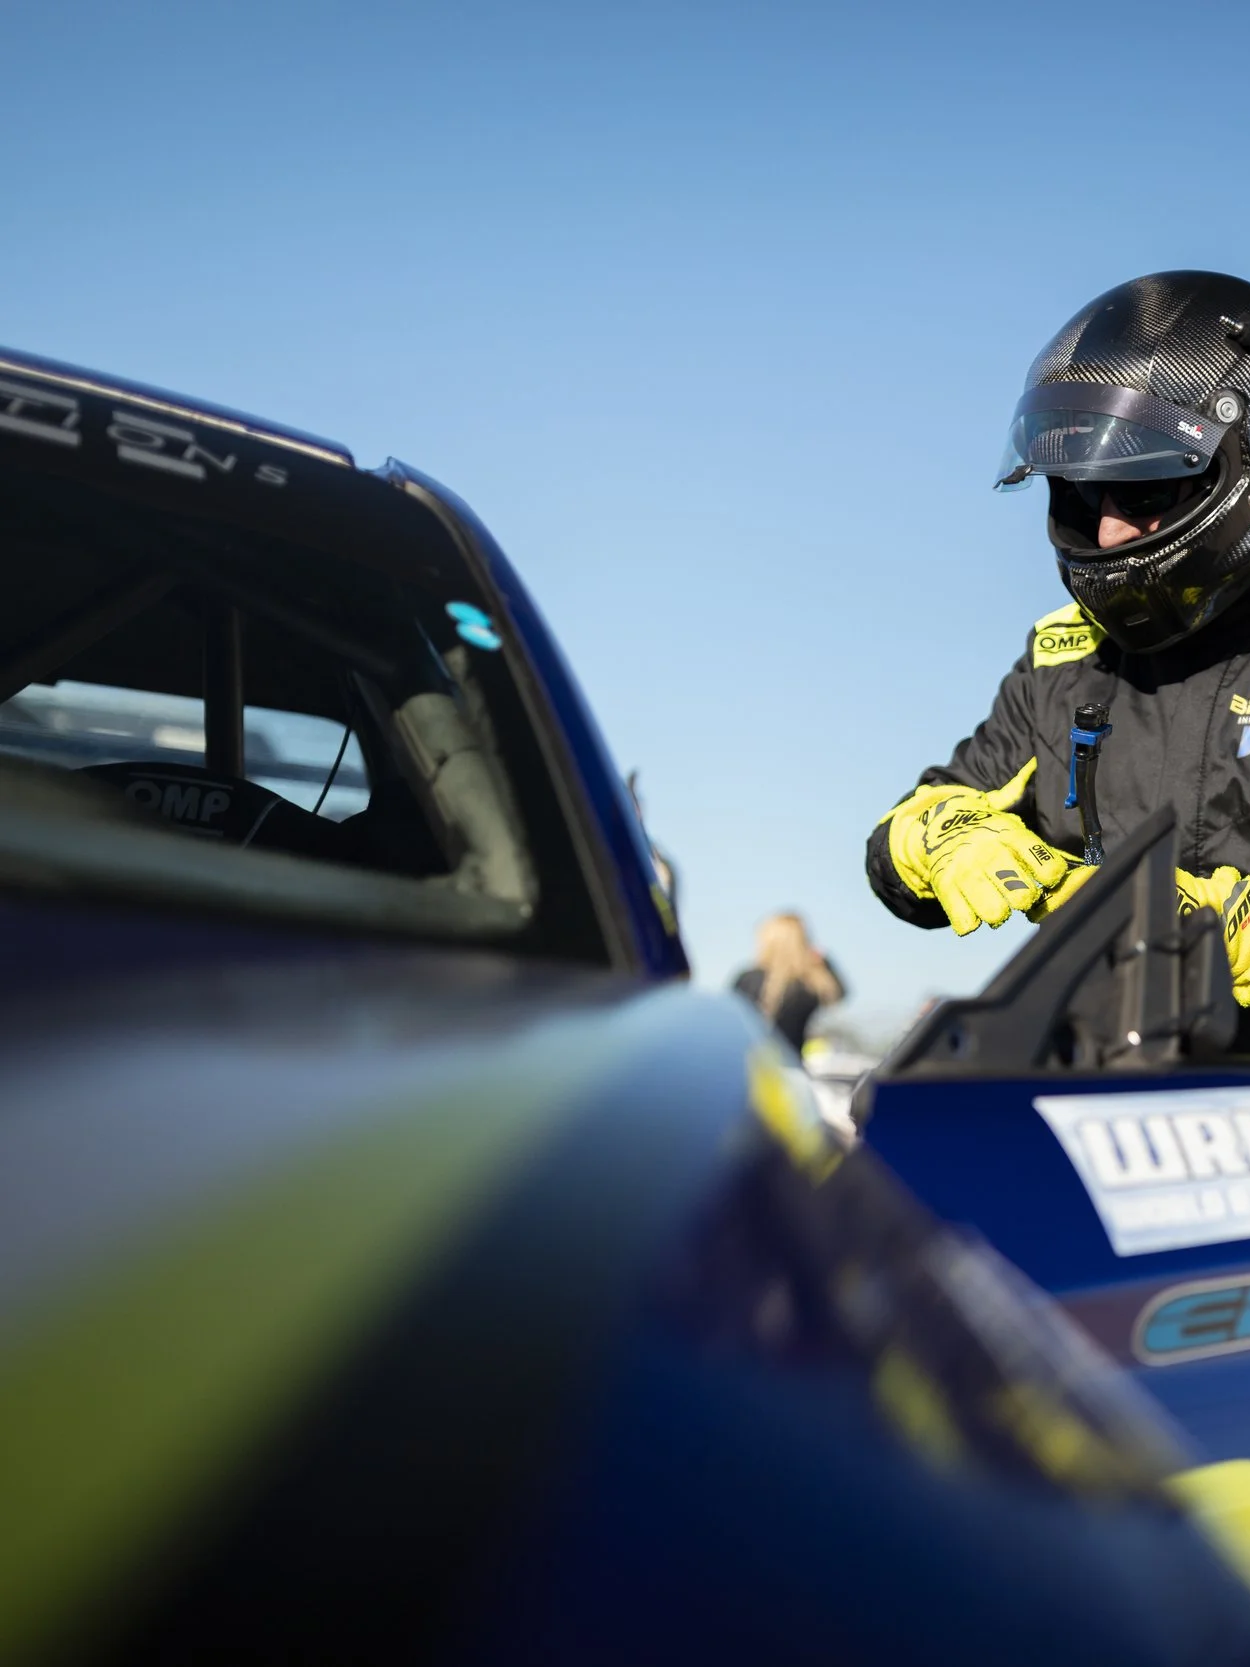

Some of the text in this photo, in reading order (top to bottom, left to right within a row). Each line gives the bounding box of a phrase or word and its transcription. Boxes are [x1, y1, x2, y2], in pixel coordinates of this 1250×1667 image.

[1040, 635, 1088, 649] OMP
[125, 780, 231, 823] OMP
[1032, 844, 1051, 862] OMP
